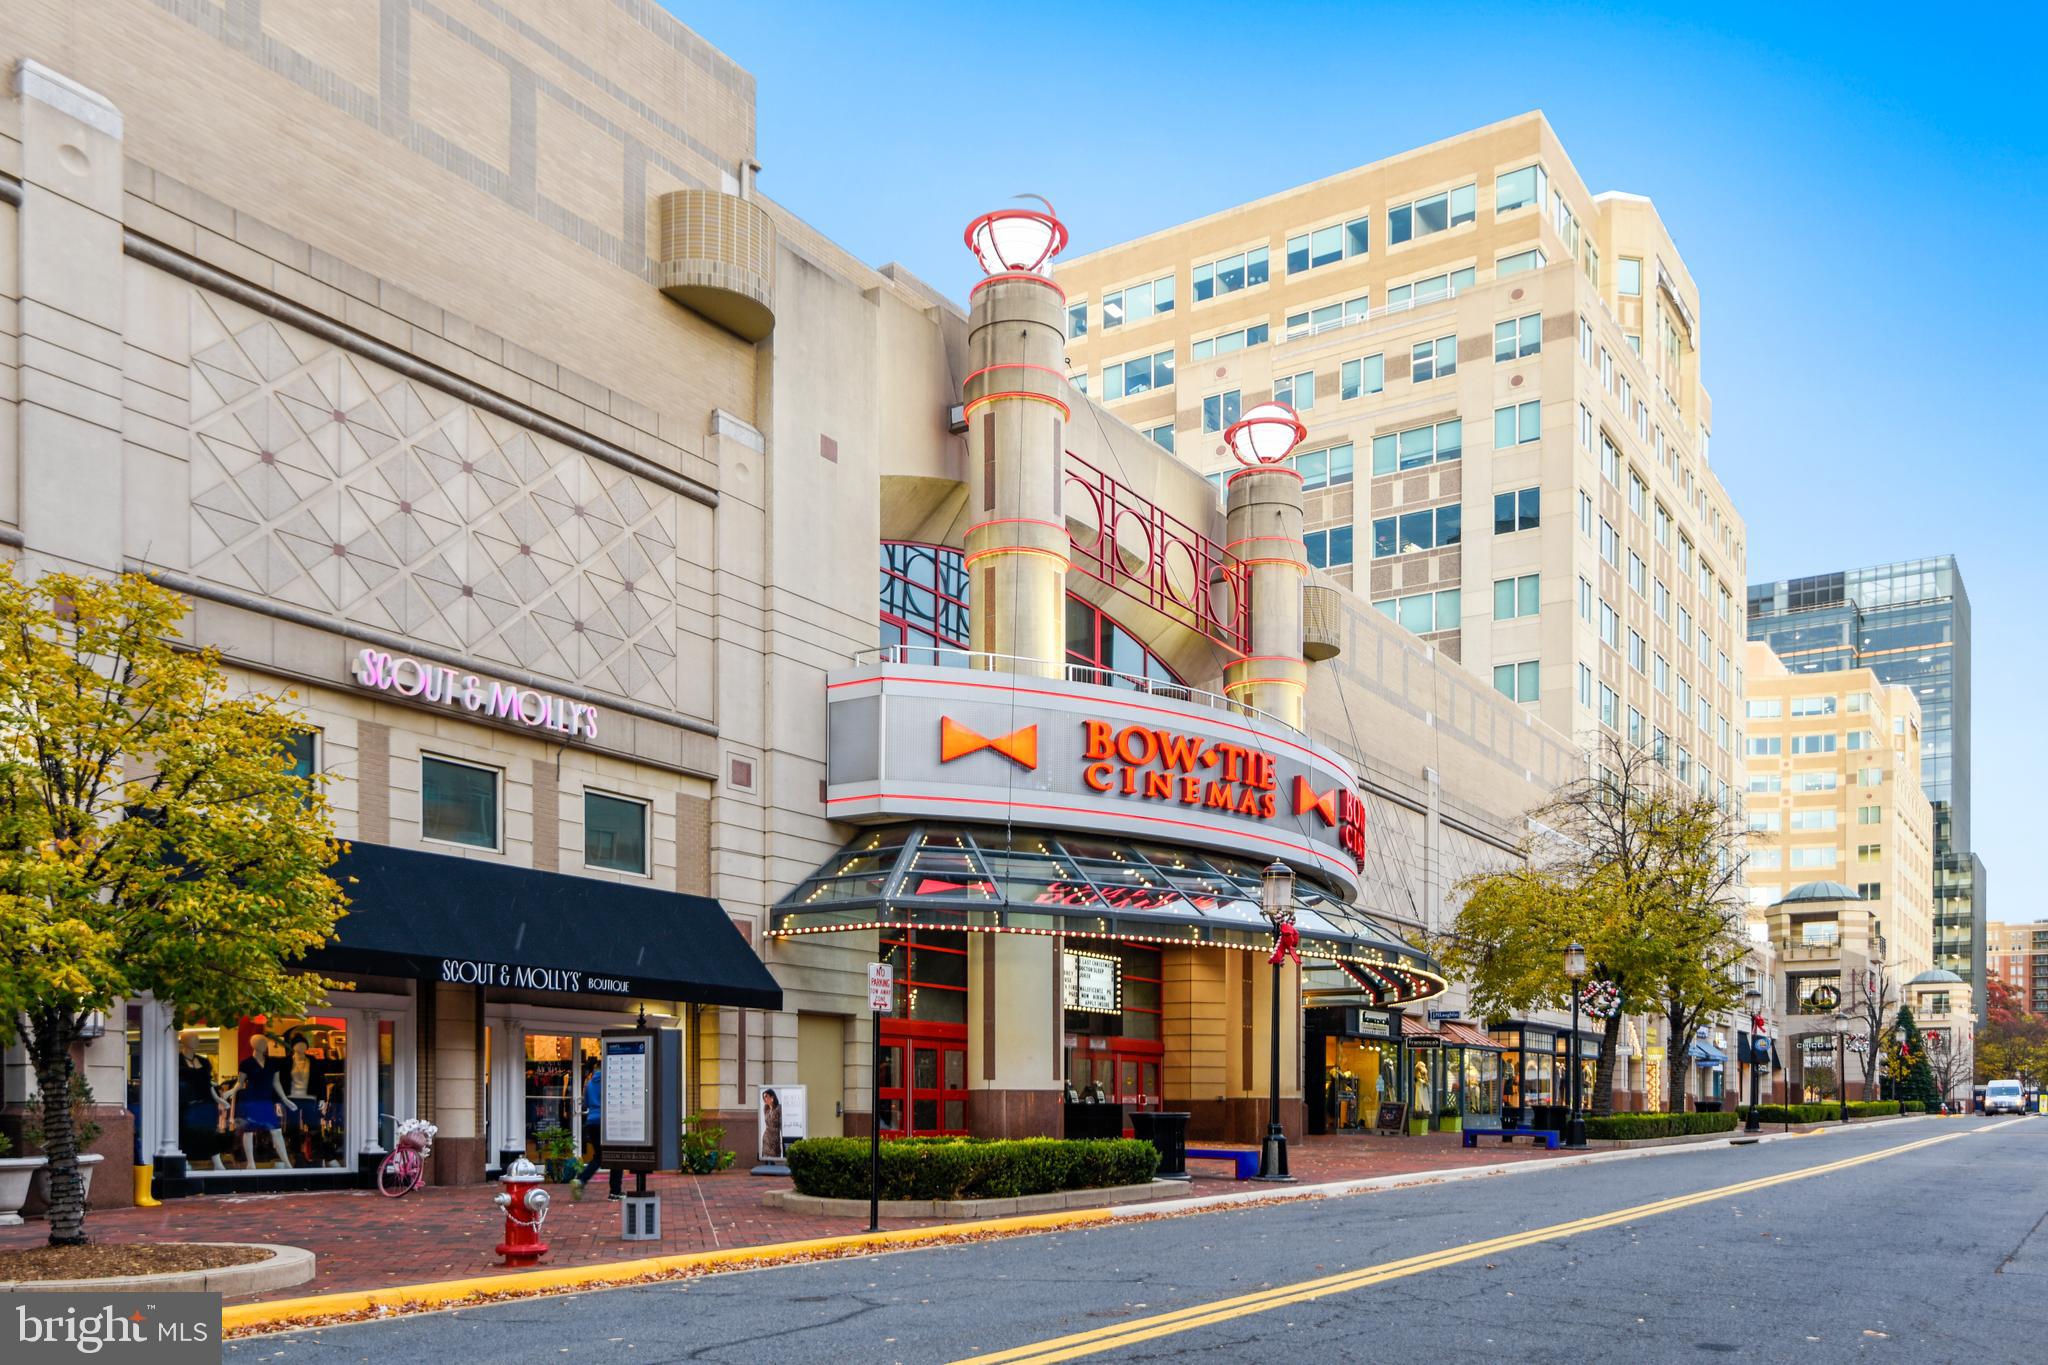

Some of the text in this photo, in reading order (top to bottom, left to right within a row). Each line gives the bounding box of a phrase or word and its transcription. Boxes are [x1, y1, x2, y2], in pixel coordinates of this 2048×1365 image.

[357, 648, 597, 739] SCOUT & MOLLY'S
[1084, 762, 1276, 818] CINEMAS
[876, 968, 886, 977] NO
[1091, 960, 1114, 968] CHRISTMAS
[443, 959, 629, 992] SCOUT & MOLLY'S BOUTIQUE
[871, 978, 890, 988] PARKING
